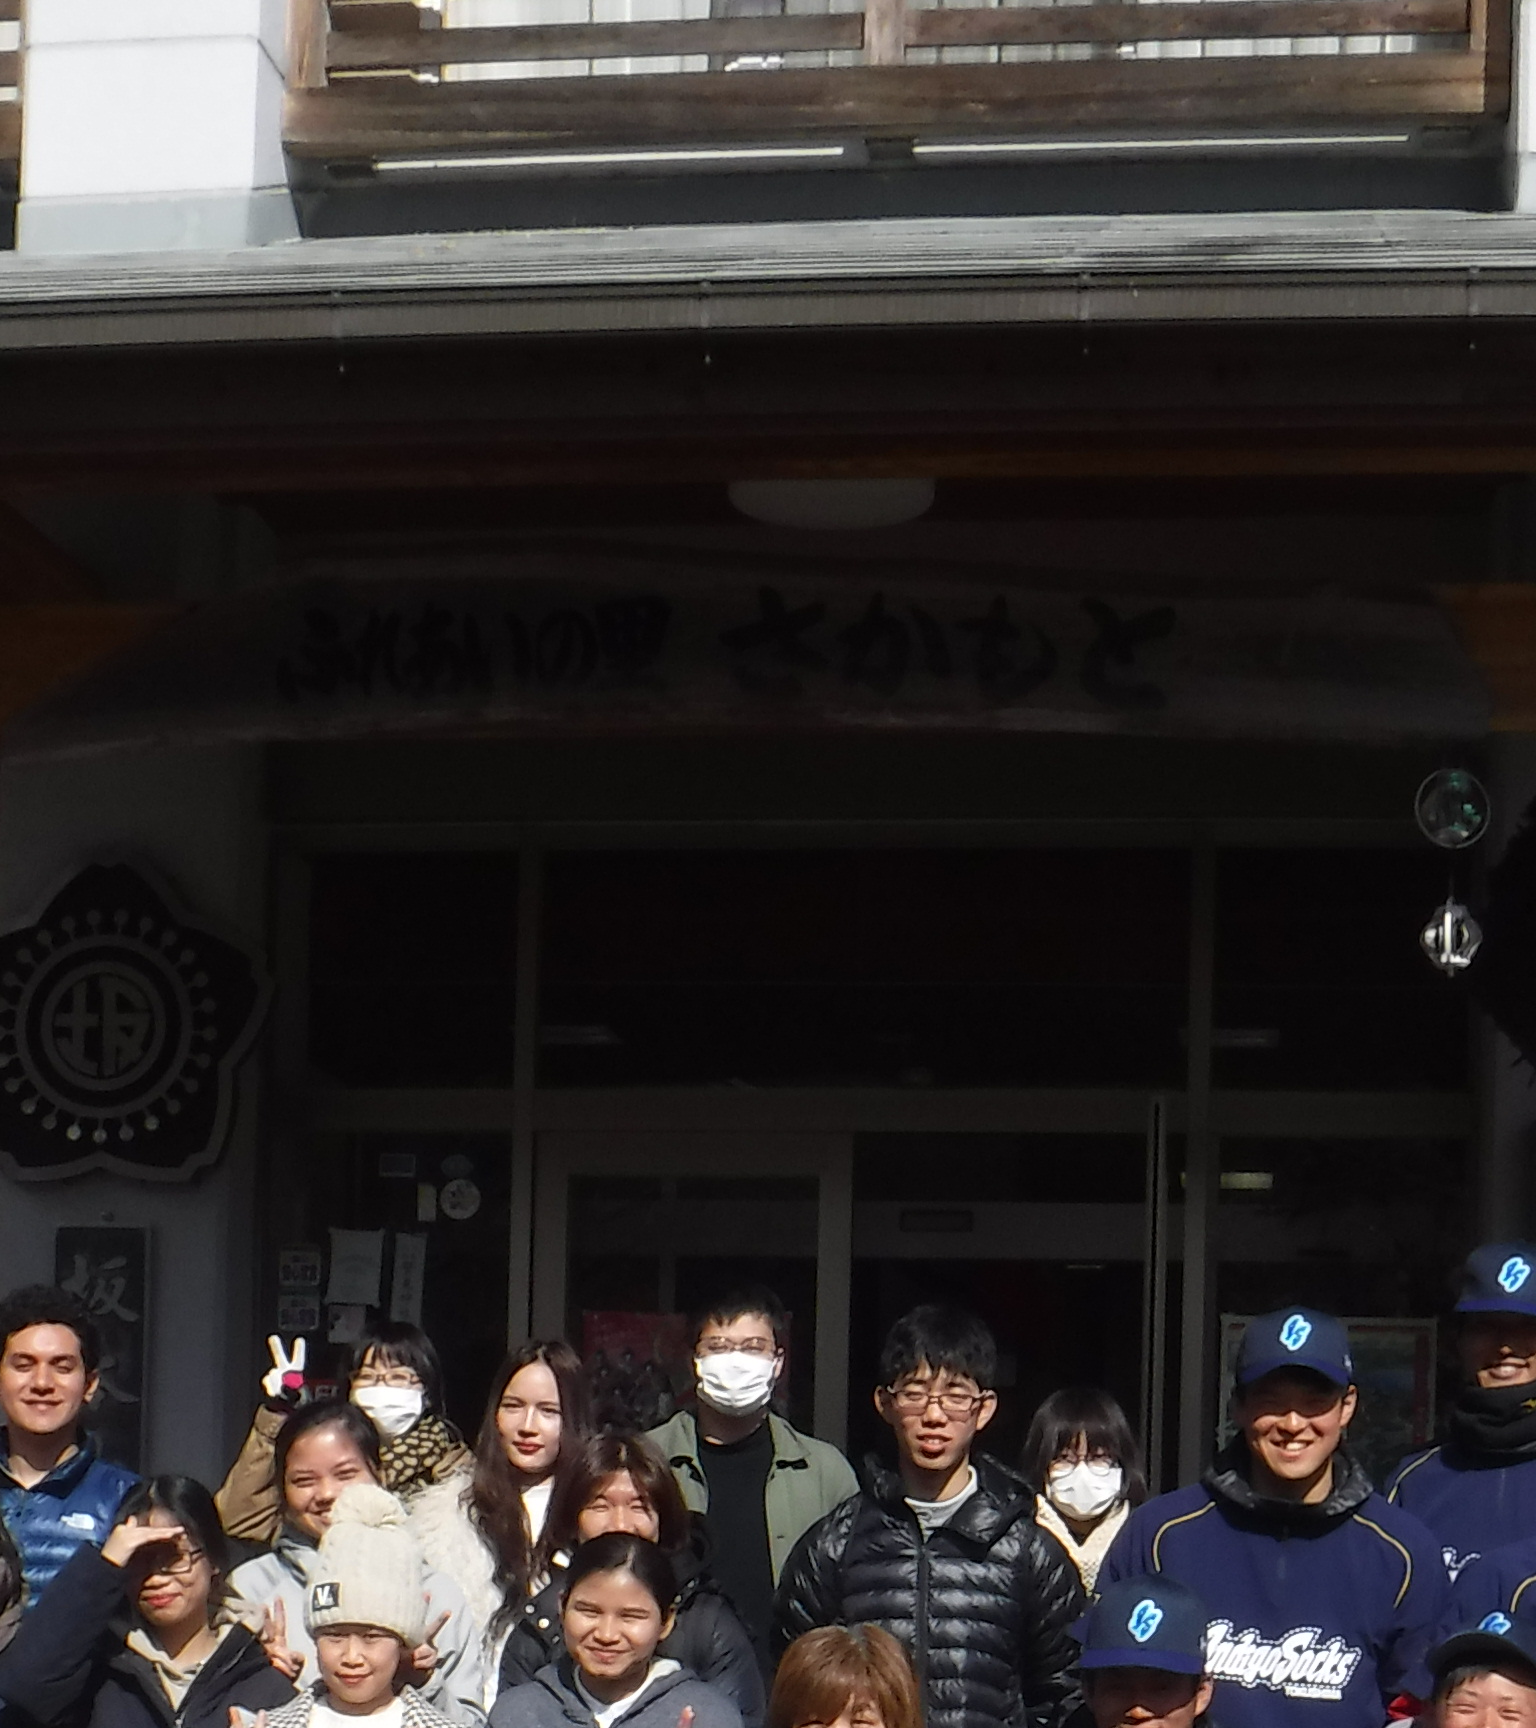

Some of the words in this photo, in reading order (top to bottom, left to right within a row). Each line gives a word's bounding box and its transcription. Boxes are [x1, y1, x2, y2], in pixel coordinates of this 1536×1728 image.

[275, 590, 674, 704] ふれあいの里
[719, 584, 1178, 712] さかもと
